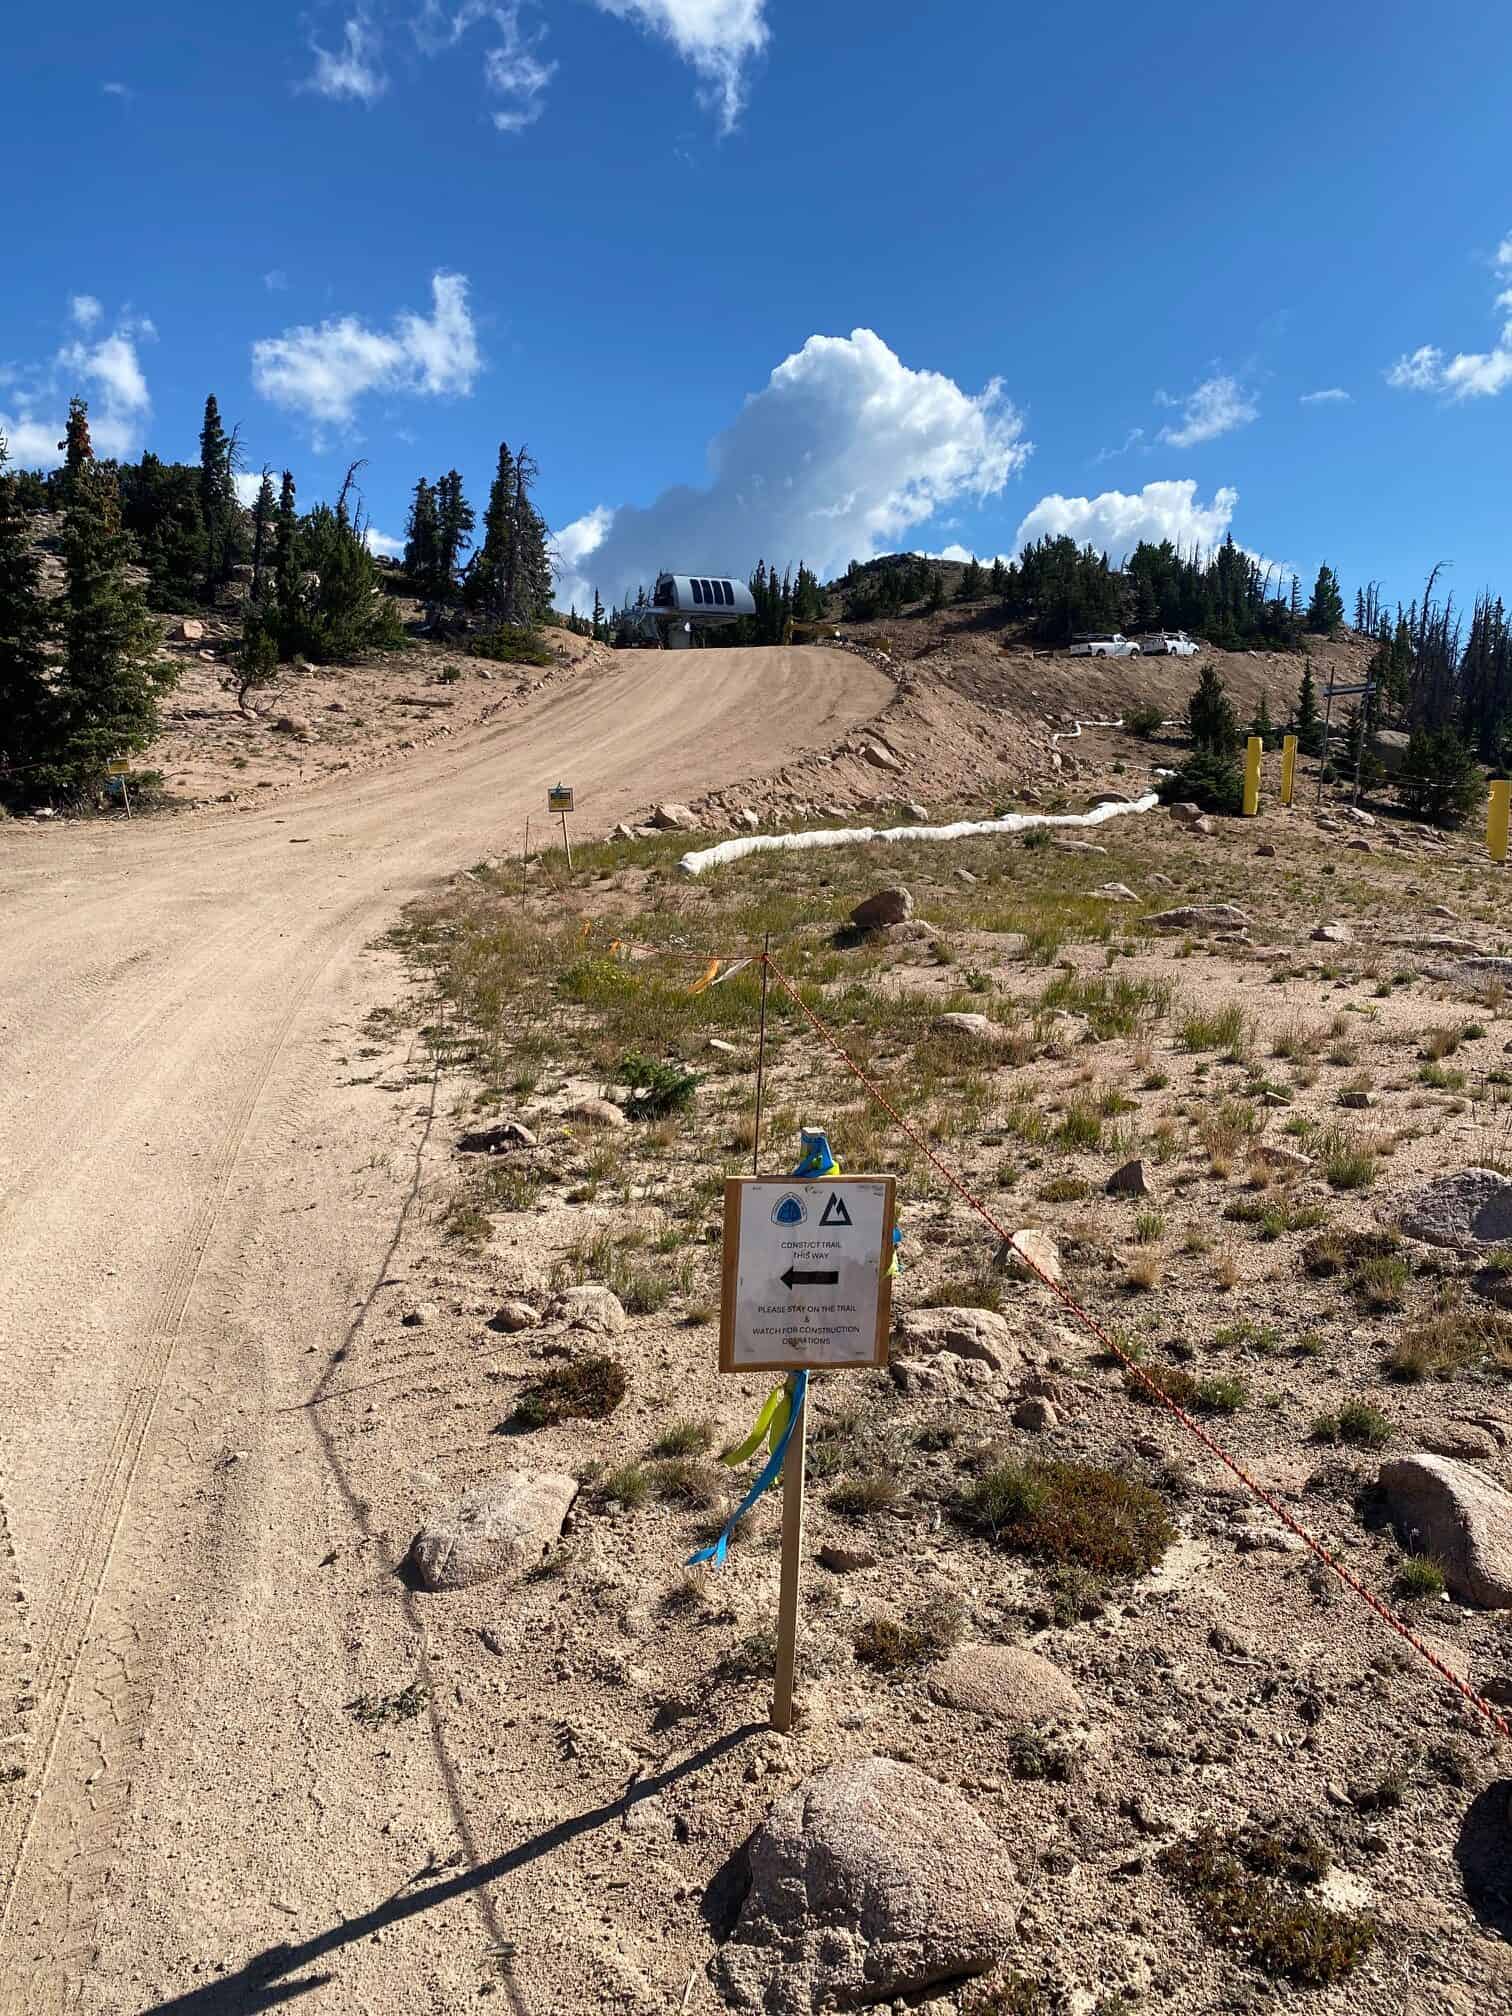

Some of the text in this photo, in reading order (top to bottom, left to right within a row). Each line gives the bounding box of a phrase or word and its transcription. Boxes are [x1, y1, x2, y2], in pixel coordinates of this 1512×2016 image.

[822, 1241, 841, 1249] TRAIL
[793, 1251, 829, 1259] THIS WAY
[758, 1305, 786, 1313] PLEASE
[787, 1305, 805, 1313] STAY
[821, 1304, 836, 1312] THE
[837, 1304, 857, 1312] TRAIL
[803, 1315, 810, 1323] &
[752, 1326, 860, 1335] WATCH FOR CONSTRUCTION
